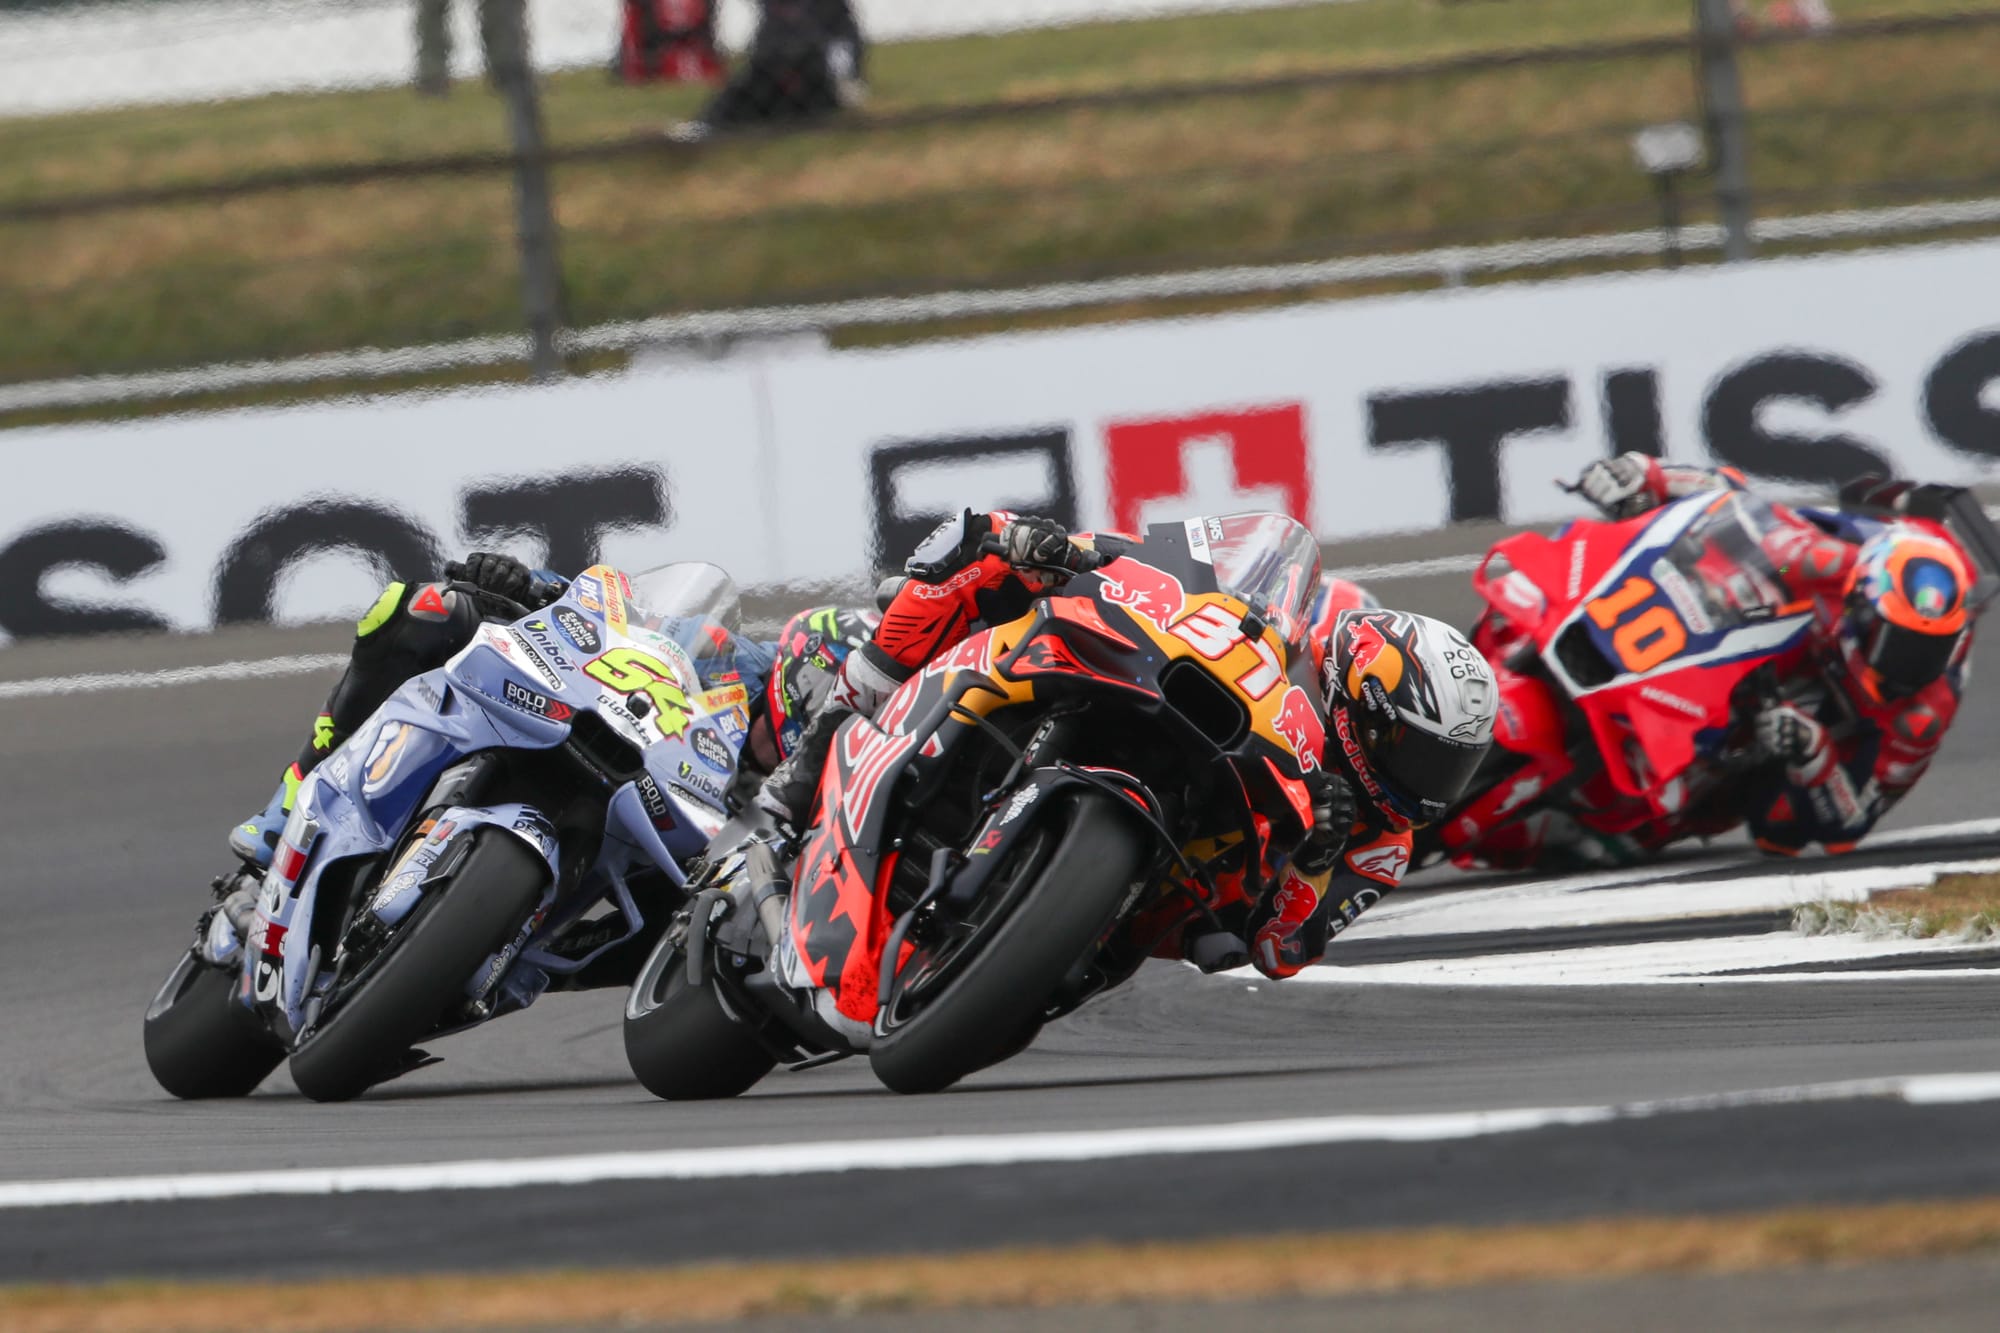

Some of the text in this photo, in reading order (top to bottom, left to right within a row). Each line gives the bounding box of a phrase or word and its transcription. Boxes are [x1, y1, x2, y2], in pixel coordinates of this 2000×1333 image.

[558, 613, 586, 648] Galicia
[566, 611, 597, 647] Estrella
[1585, 576, 1686, 673] 10
[524, 619, 576, 672] Unibat
[507, 681, 546, 709] BOLD
[582, 647, 694, 745] 54
[641, 775, 667, 816] BOLD
[678, 760, 722, 799] Uniba
